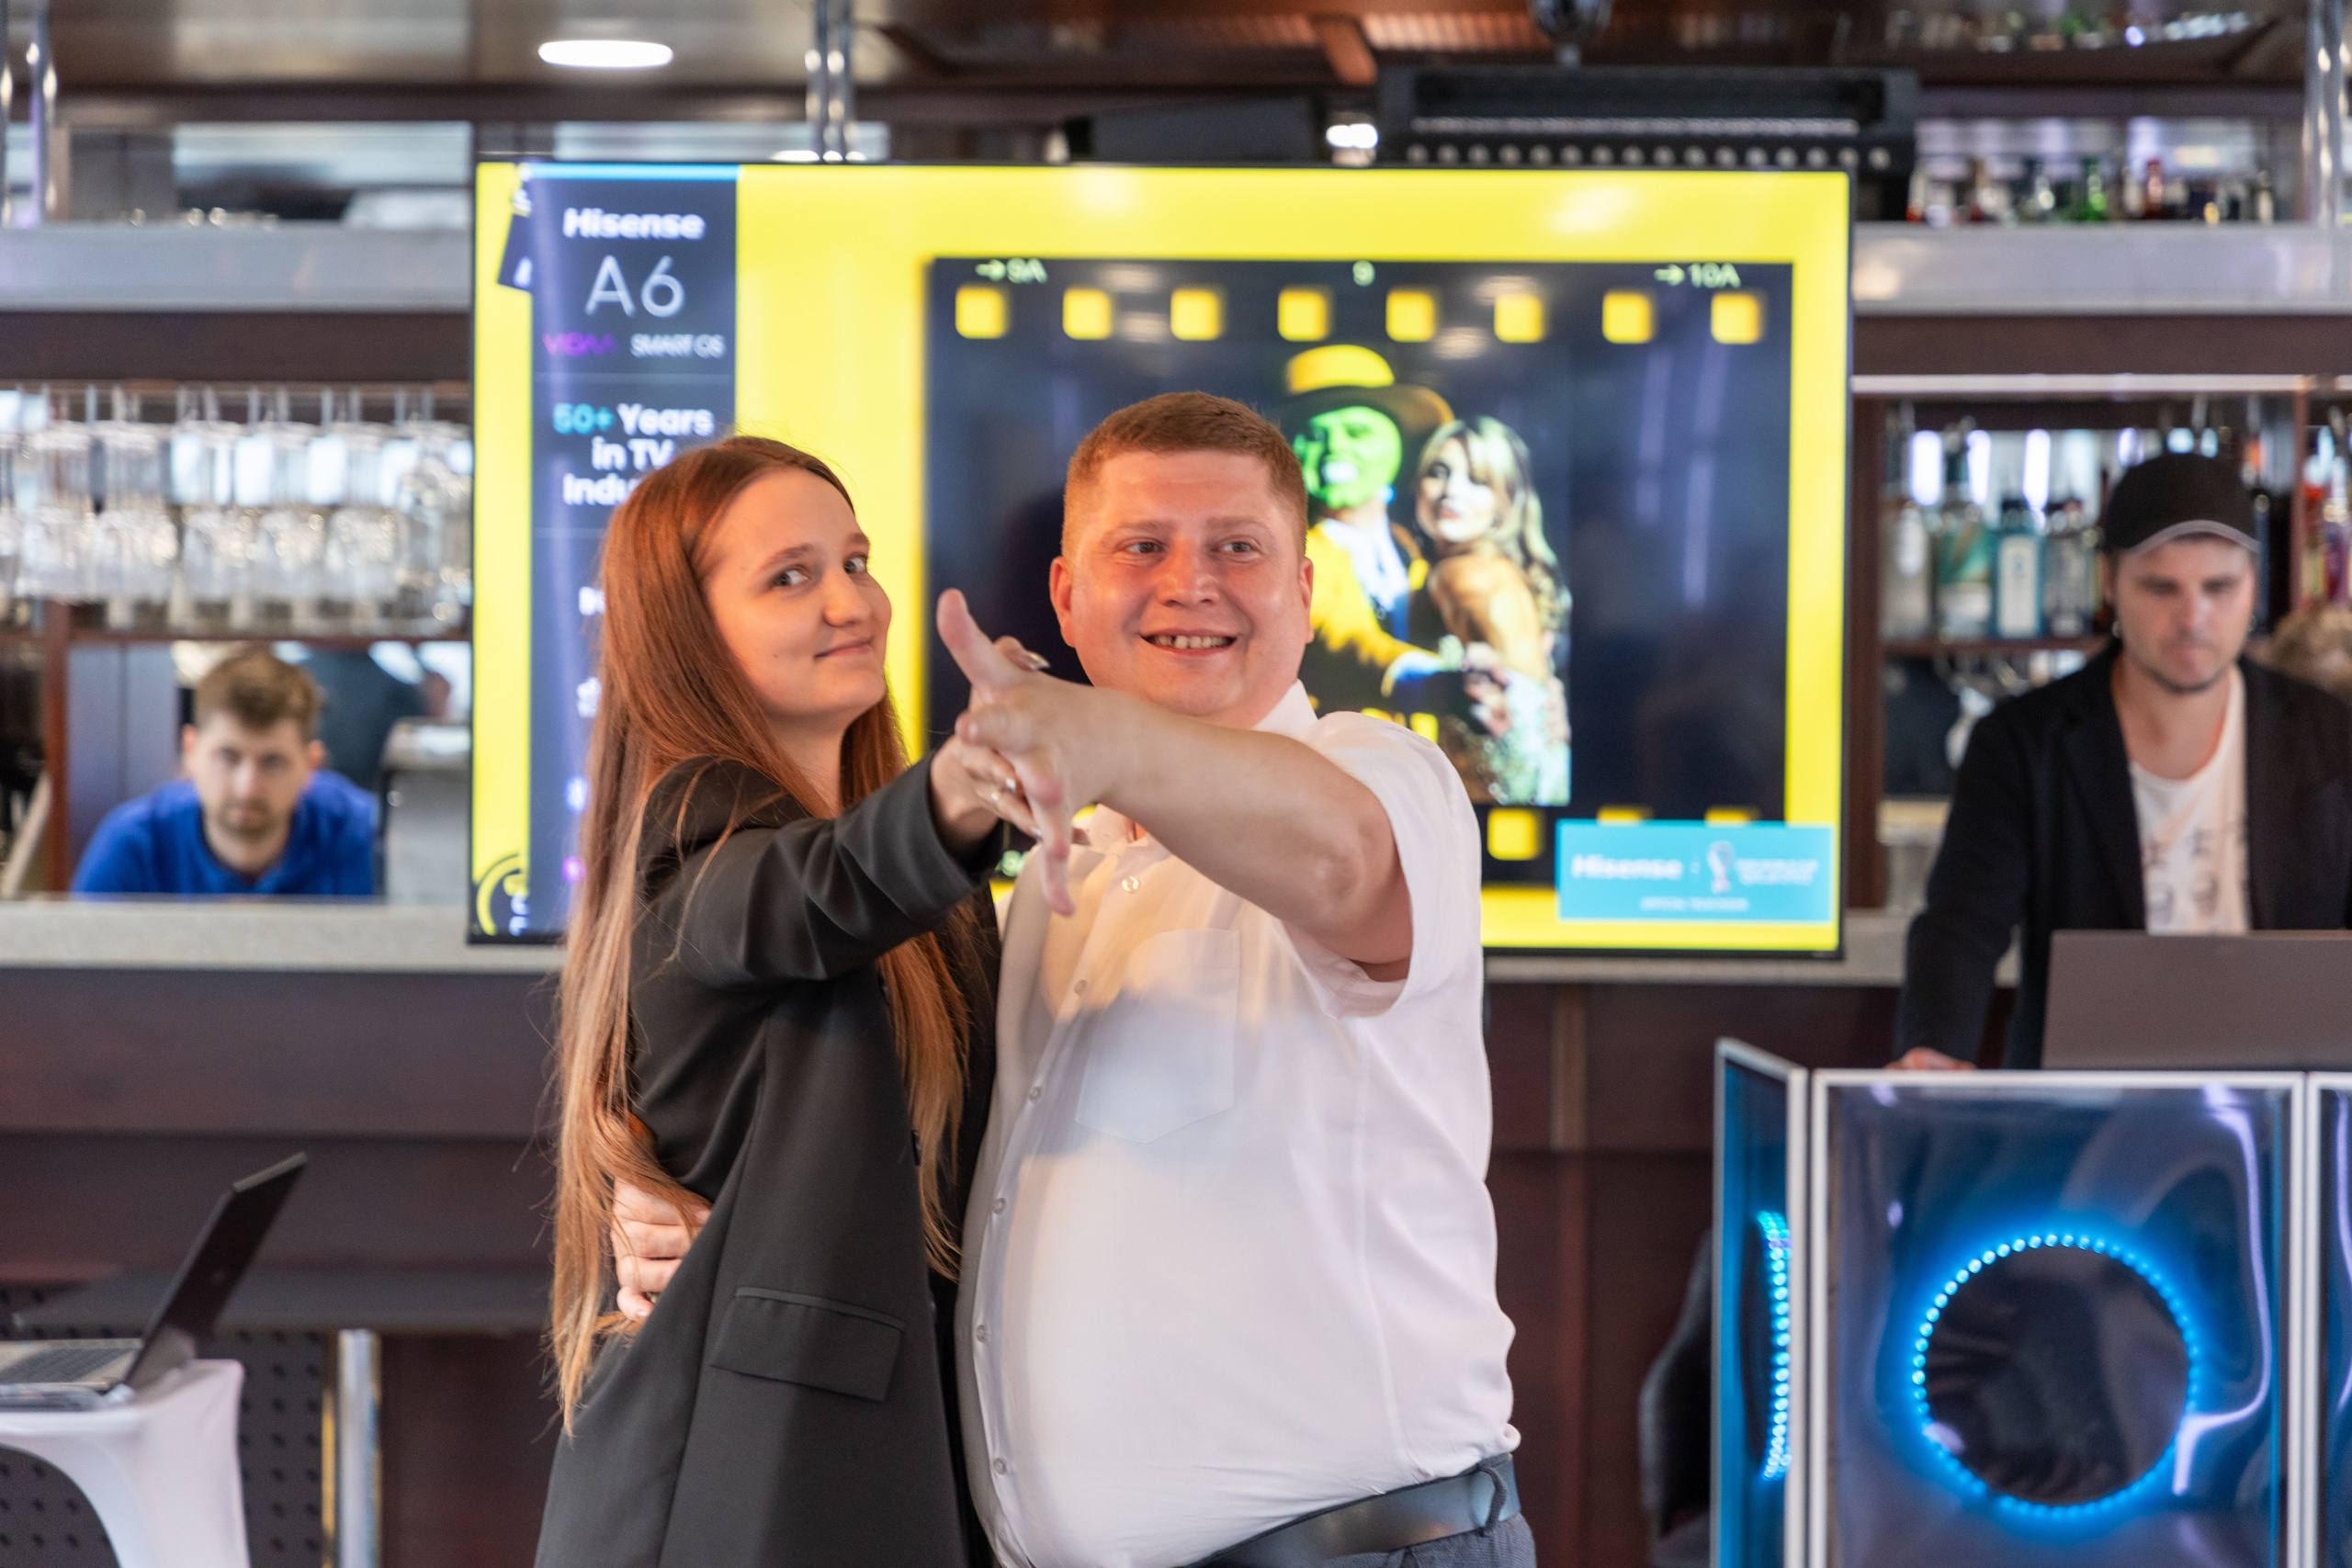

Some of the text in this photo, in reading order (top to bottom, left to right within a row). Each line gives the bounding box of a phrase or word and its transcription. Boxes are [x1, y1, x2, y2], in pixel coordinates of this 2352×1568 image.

[562, 208, 706, 239] Hisense
[585, 254, 685, 318] A6
[1688, 262, 1741, 288] 10A
[553, 403, 716, 436] 50+ Years
[592, 435, 674, 471] in TV
